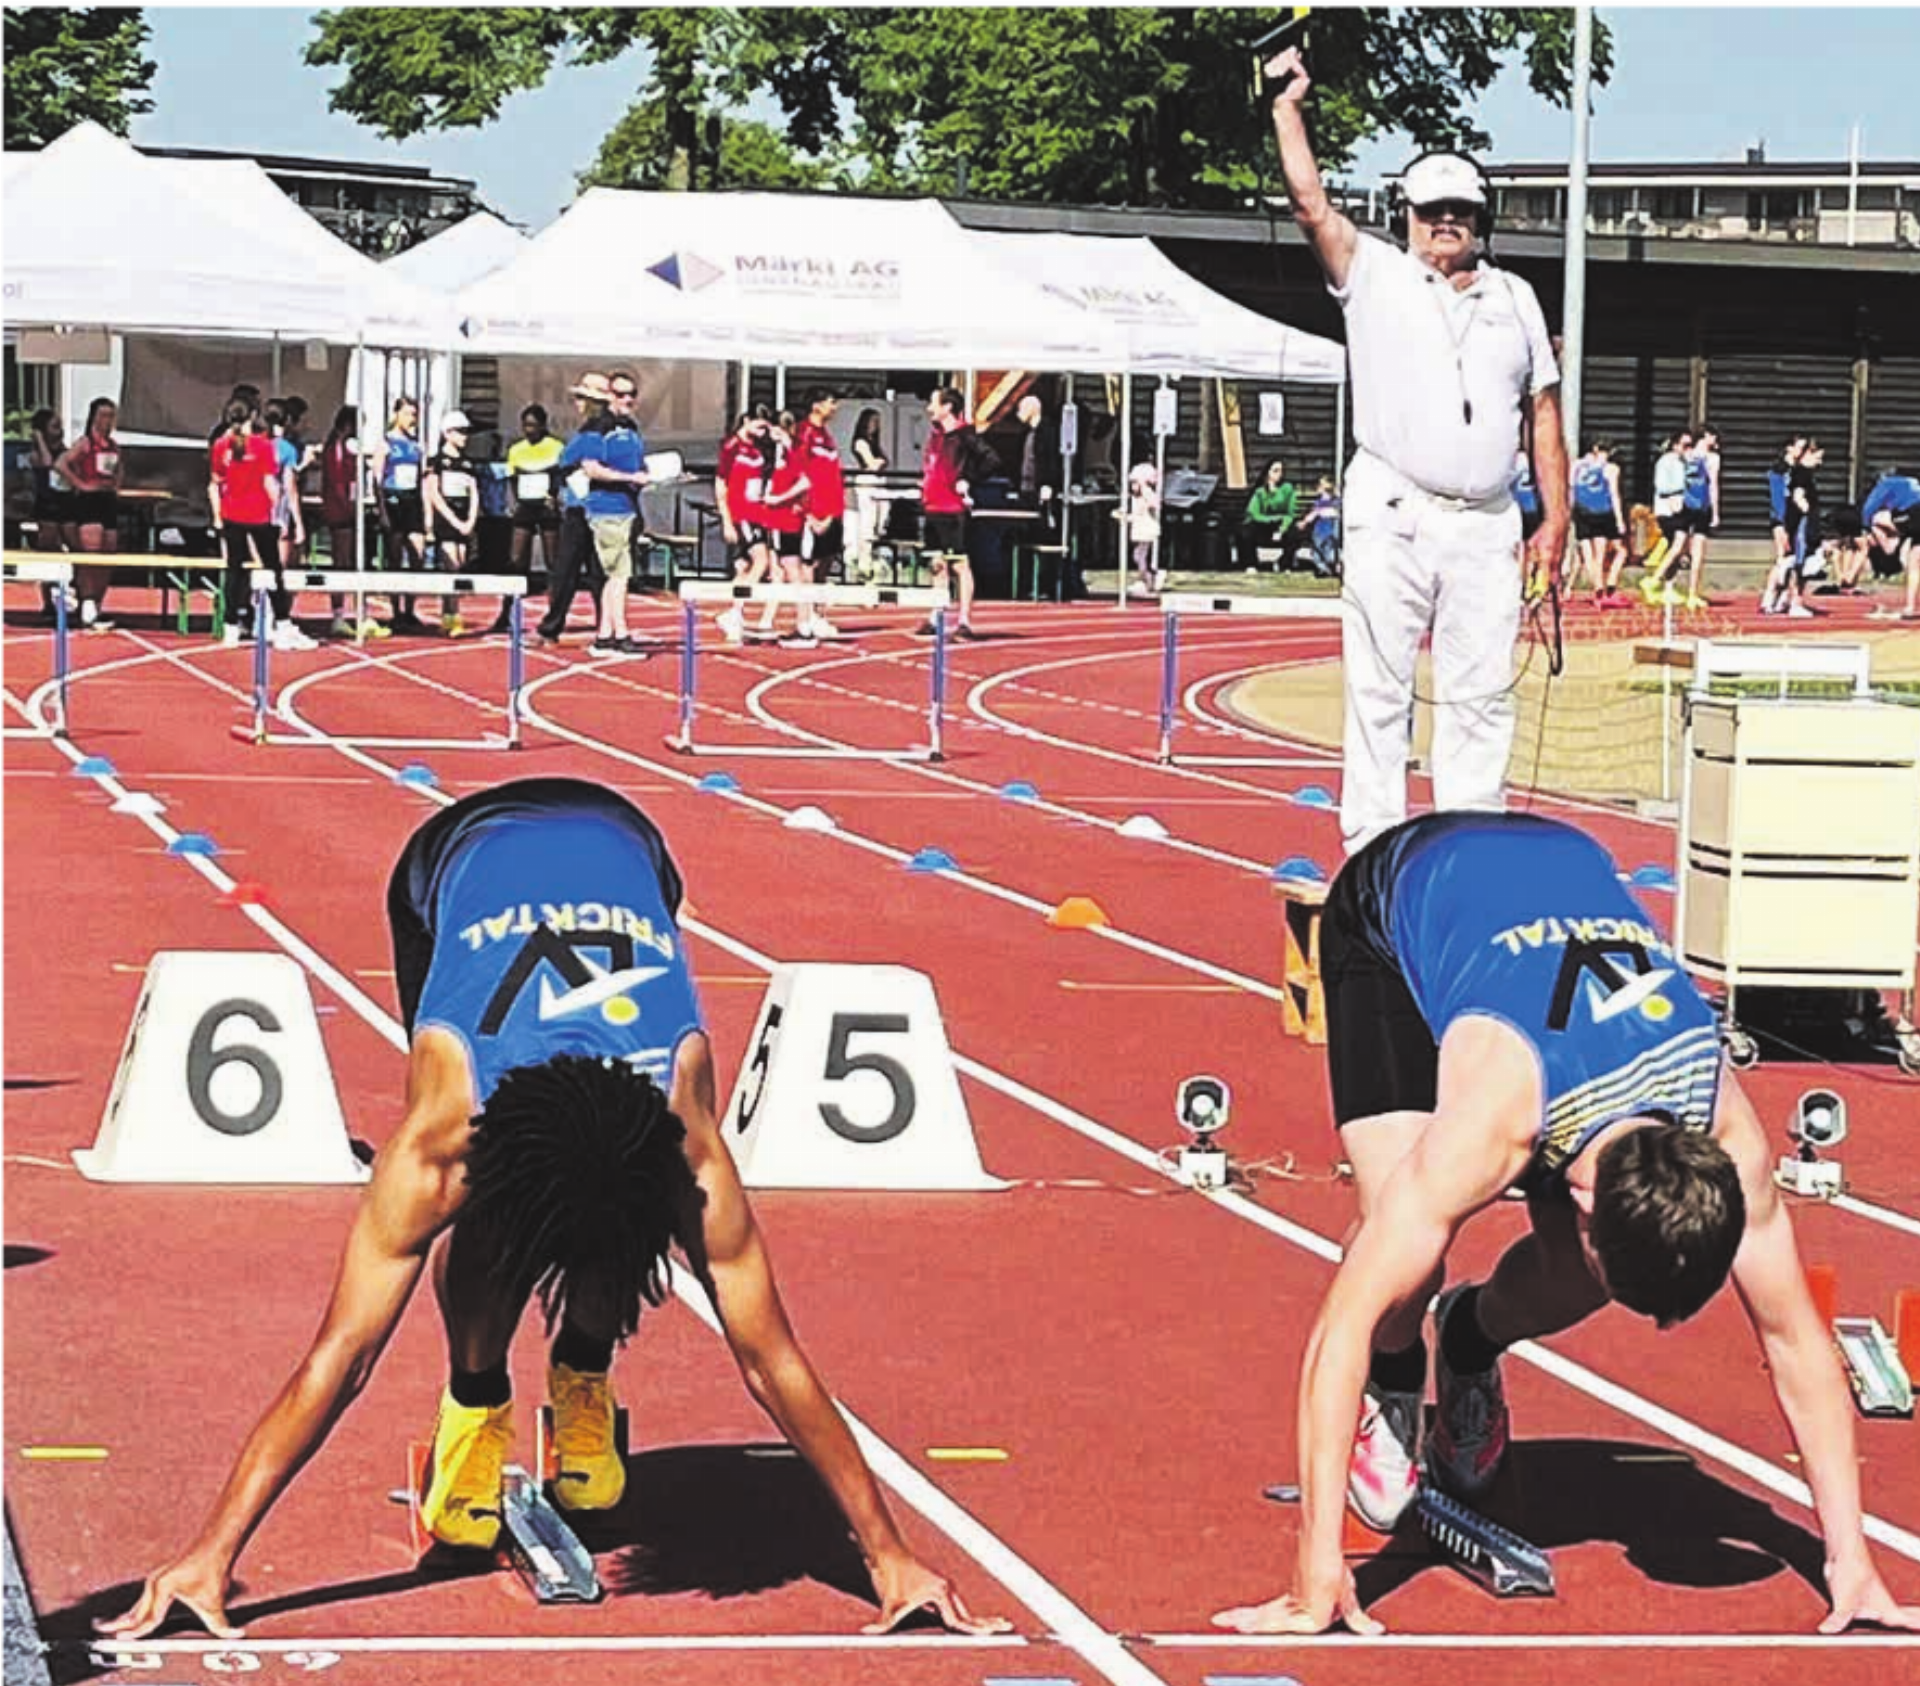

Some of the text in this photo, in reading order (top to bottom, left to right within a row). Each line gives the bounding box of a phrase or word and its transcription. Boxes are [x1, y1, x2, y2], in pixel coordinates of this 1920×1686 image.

[849, 259, 900, 278] AG
[459, 902, 675, 961] FRICKTAL
[186, 997, 283, 1137] 6
[818, 1011, 917, 1144] 5
